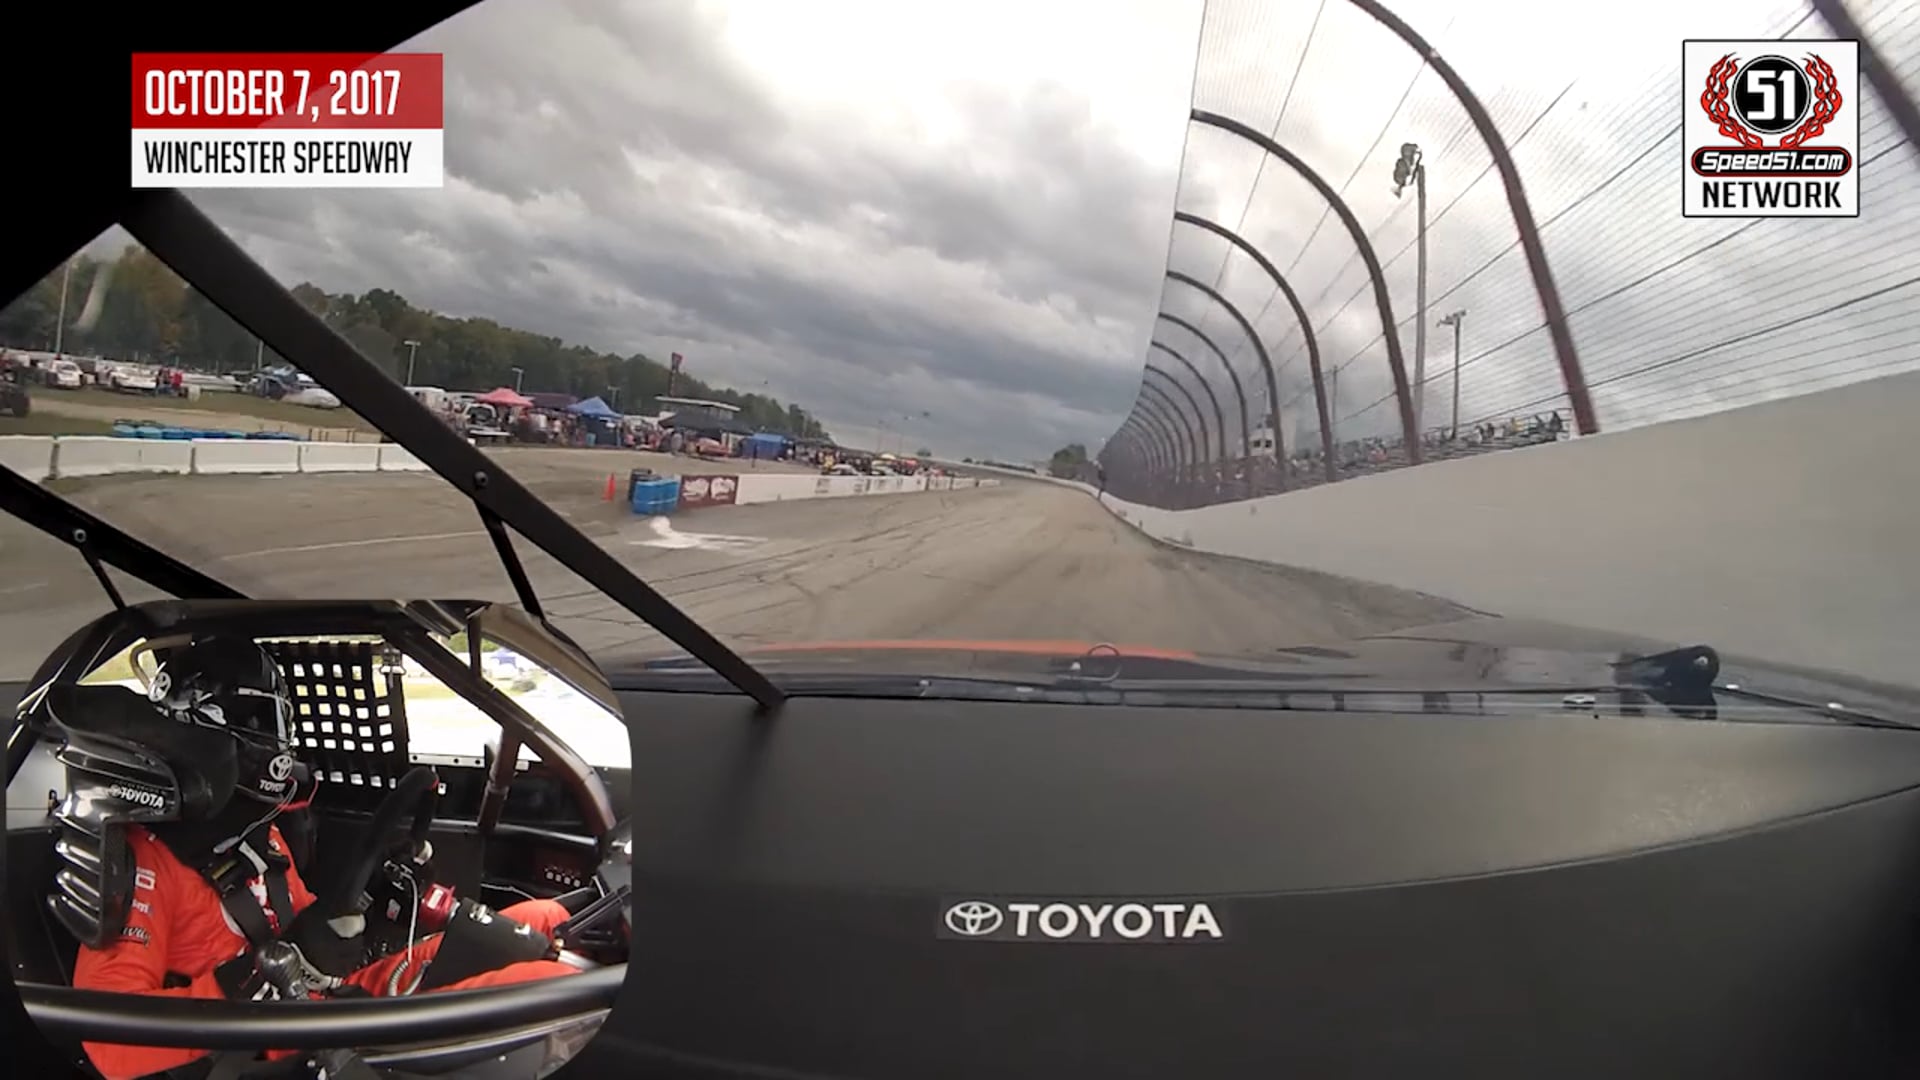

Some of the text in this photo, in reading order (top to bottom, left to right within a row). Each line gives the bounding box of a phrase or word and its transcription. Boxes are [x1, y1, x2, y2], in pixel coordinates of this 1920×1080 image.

[259, 778, 286, 793] TOYOT
[120, 786, 165, 809] TOYOTA
[1008, 903, 1223, 939] TOYOTA
